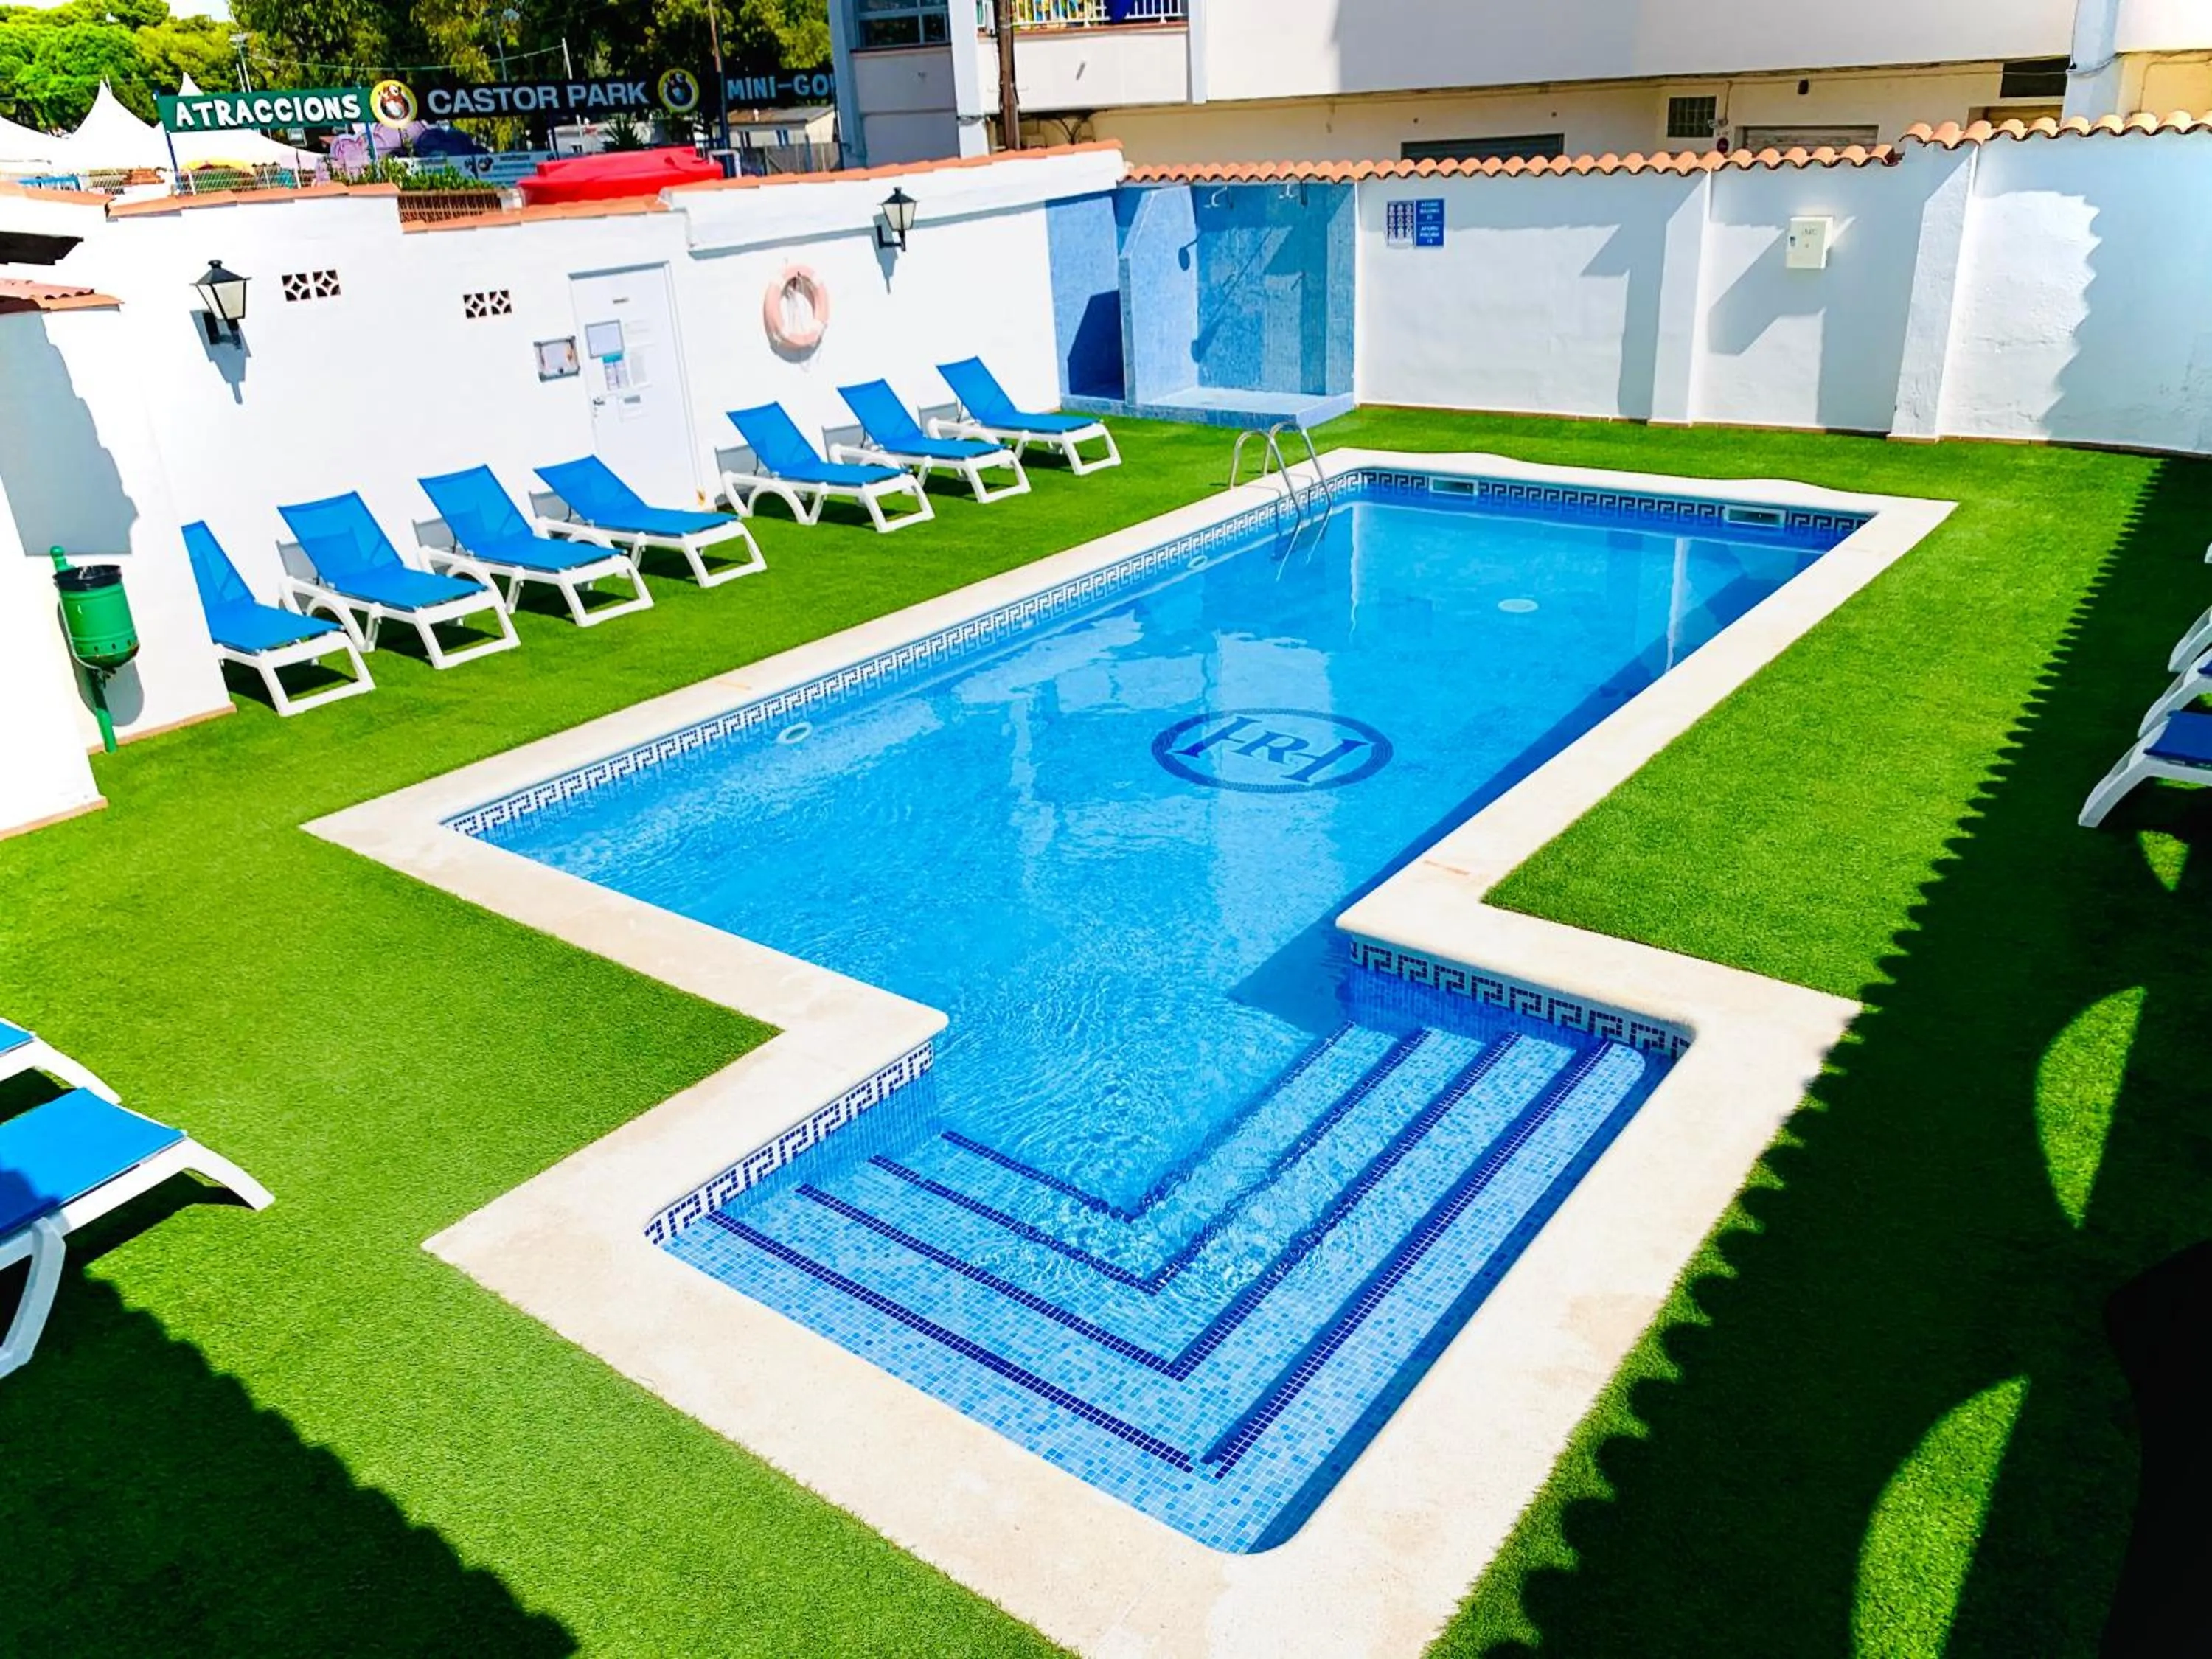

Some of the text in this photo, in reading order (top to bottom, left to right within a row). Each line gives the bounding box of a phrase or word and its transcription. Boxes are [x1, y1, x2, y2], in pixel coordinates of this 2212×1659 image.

[175, 94, 361, 127] ATRACCIONS
[427, 82, 649, 114] CASTOR PARK
